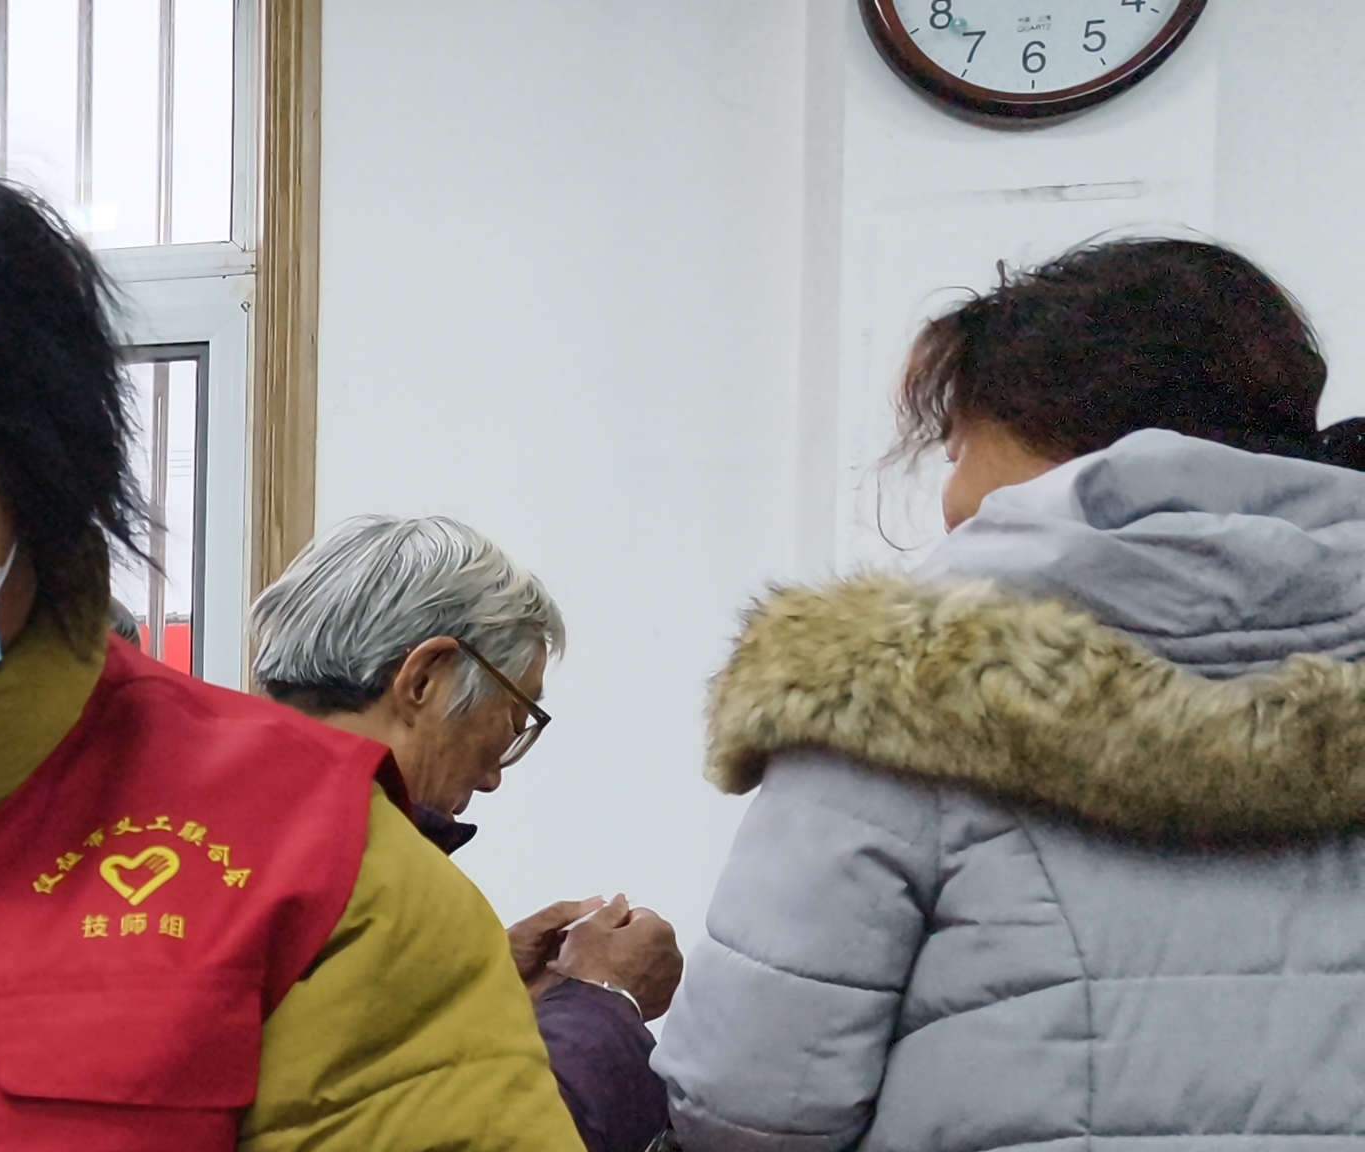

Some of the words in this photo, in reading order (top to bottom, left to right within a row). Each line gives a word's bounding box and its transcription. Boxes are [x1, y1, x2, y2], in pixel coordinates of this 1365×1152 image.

[962, 30, 987, 63] 7
[1082, 19, 1107, 53] 5
[1021, 40, 1047, 74] 6
[81, 912, 186, 939] 技师组
